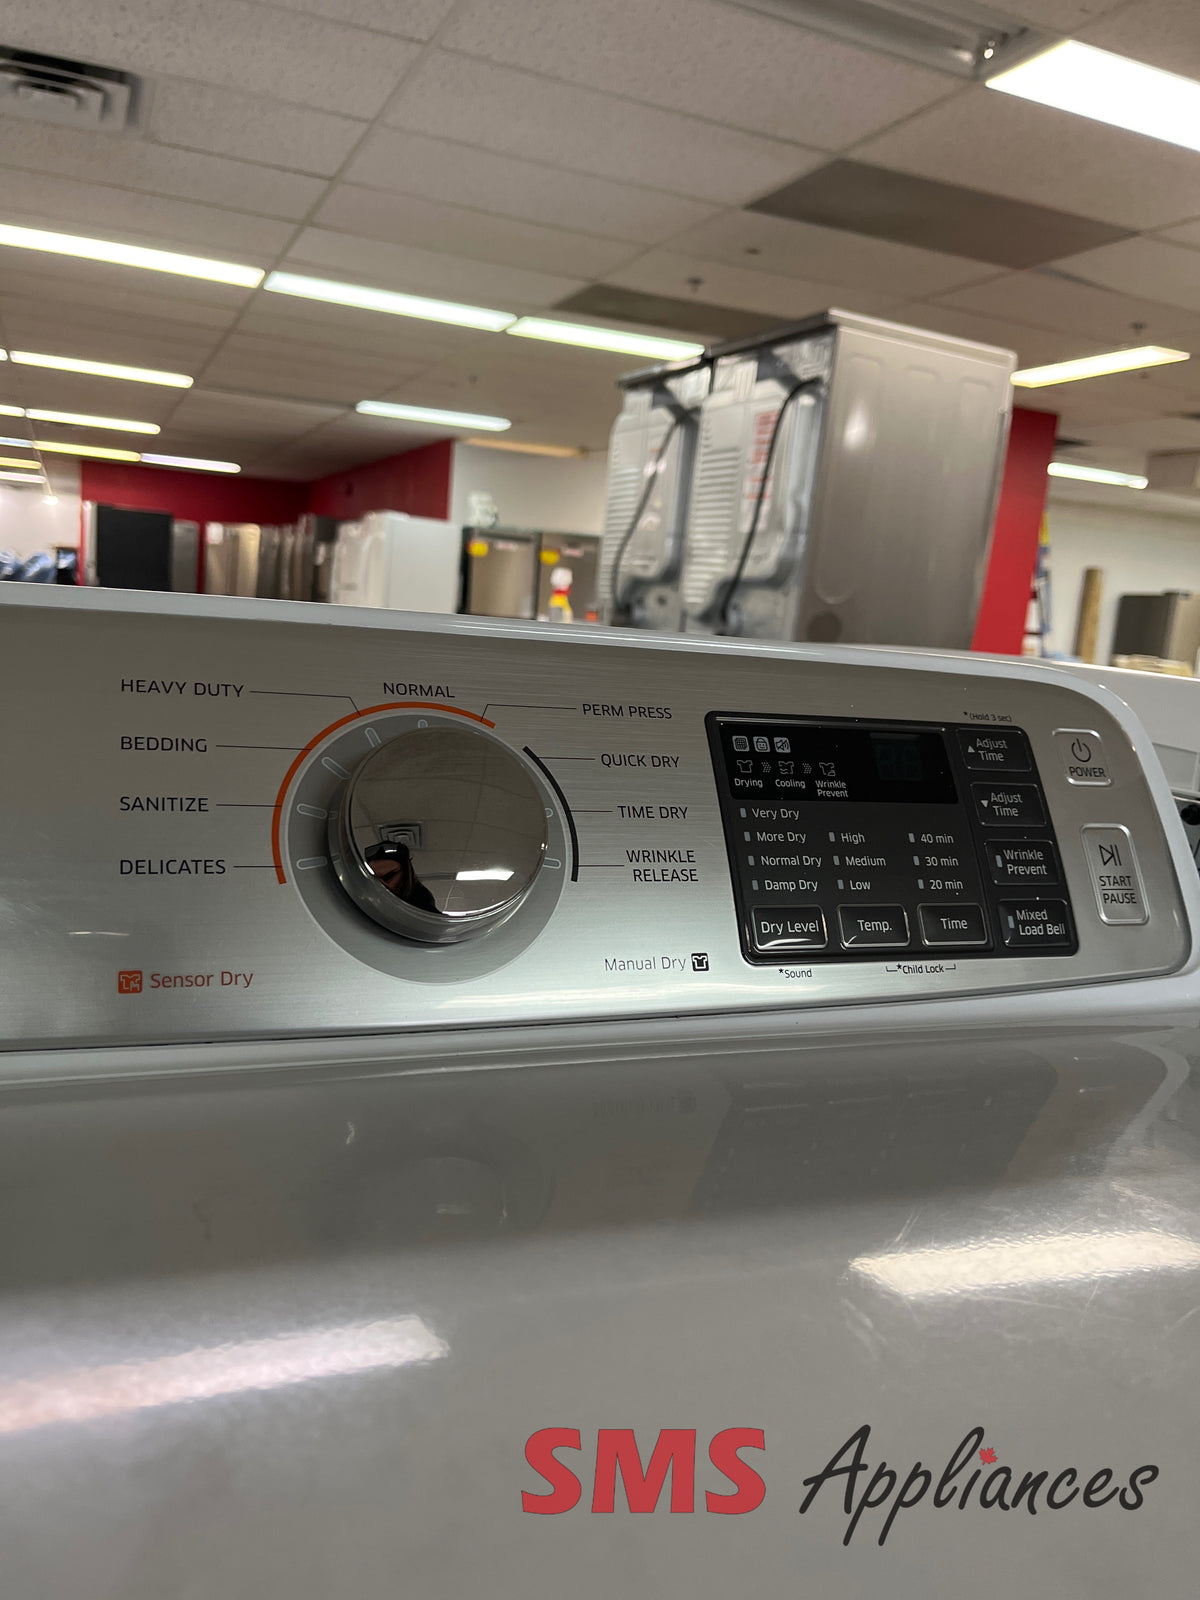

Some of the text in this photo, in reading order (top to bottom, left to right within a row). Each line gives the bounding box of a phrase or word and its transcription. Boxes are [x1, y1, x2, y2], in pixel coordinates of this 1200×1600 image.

[121, 679, 244, 697] HEAVY DUTY
[383, 682, 455, 698] NORMAL
[582, 703, 672, 719] PERM PRESS
[121, 736, 207, 752] BEDDING
[976, 738, 1007, 750] Adjust
[601, 754, 680, 768] QUICK DRY
[978, 750, 1004, 762] Time
[1069, 766, 1106, 778] POWER
[734, 778, 763, 788] Drying
[775, 779, 806, 788] Cooling
[815, 780, 847, 789] Wrinkle
[817, 789, 849, 798] Prevent
[991, 792, 1023, 804] Adjust
[120, 797, 209, 812] SANITIZE
[617, 806, 688, 819] TIME DRY
[752, 808, 799, 820] Very Dry
[993, 806, 1019, 817] Time
[757, 832, 806, 844] More Dry
[841, 832, 865, 844] High
[921, 833, 954, 844] 40 min
[626, 850, 695, 863] WRINKLE
[846, 855, 886, 866] Medium
[925, 856, 958, 866] 30 min
[1003, 849, 1044, 861] Wrinkle
[120, 860, 226, 875] DELICATES
[761, 855, 822, 868] Normal Dry
[633, 869, 699, 882] RELEASE
[1007, 864, 1047, 876] Prevent
[765, 879, 818, 892] Damp Dry
[850, 880, 871, 890] Low
[930, 879, 963, 890] 20 min
[1099, 876, 1133, 886] START
[1103, 893, 1137, 904] PAUSE
[1016, 910, 1048, 921] Mixed
[761, 920, 820, 934] Dry Level
[857, 919, 893, 932] Temp.
[940, 918, 968, 930] Time
[1019, 923, 1066, 936] Load Bell
[605, 956, 686, 972] Manual Dry
[925, 964, 944, 974] Lock
[150, 971, 253, 989] Sensor Dry
